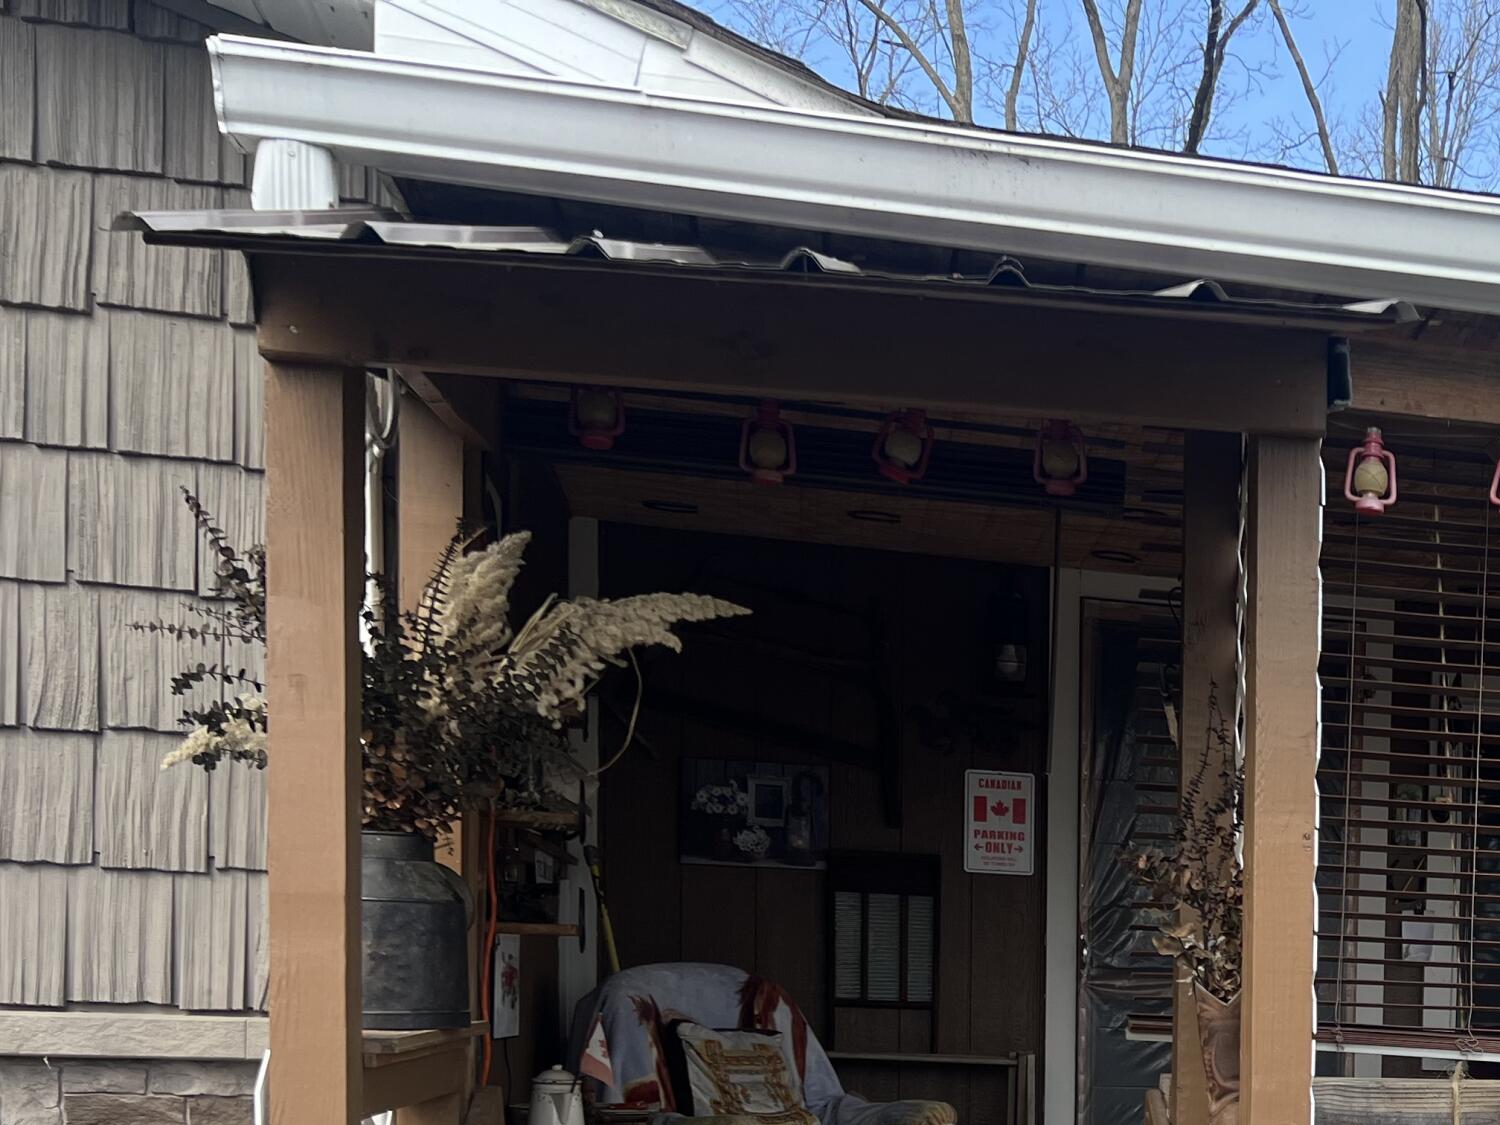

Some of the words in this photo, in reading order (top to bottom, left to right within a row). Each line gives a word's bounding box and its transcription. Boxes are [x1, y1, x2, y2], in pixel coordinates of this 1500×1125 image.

[978, 778, 1022, 790] CANADIAN
[974, 829, 1025, 841] PARKING
[985, 842, 1013, 854] ONLY
